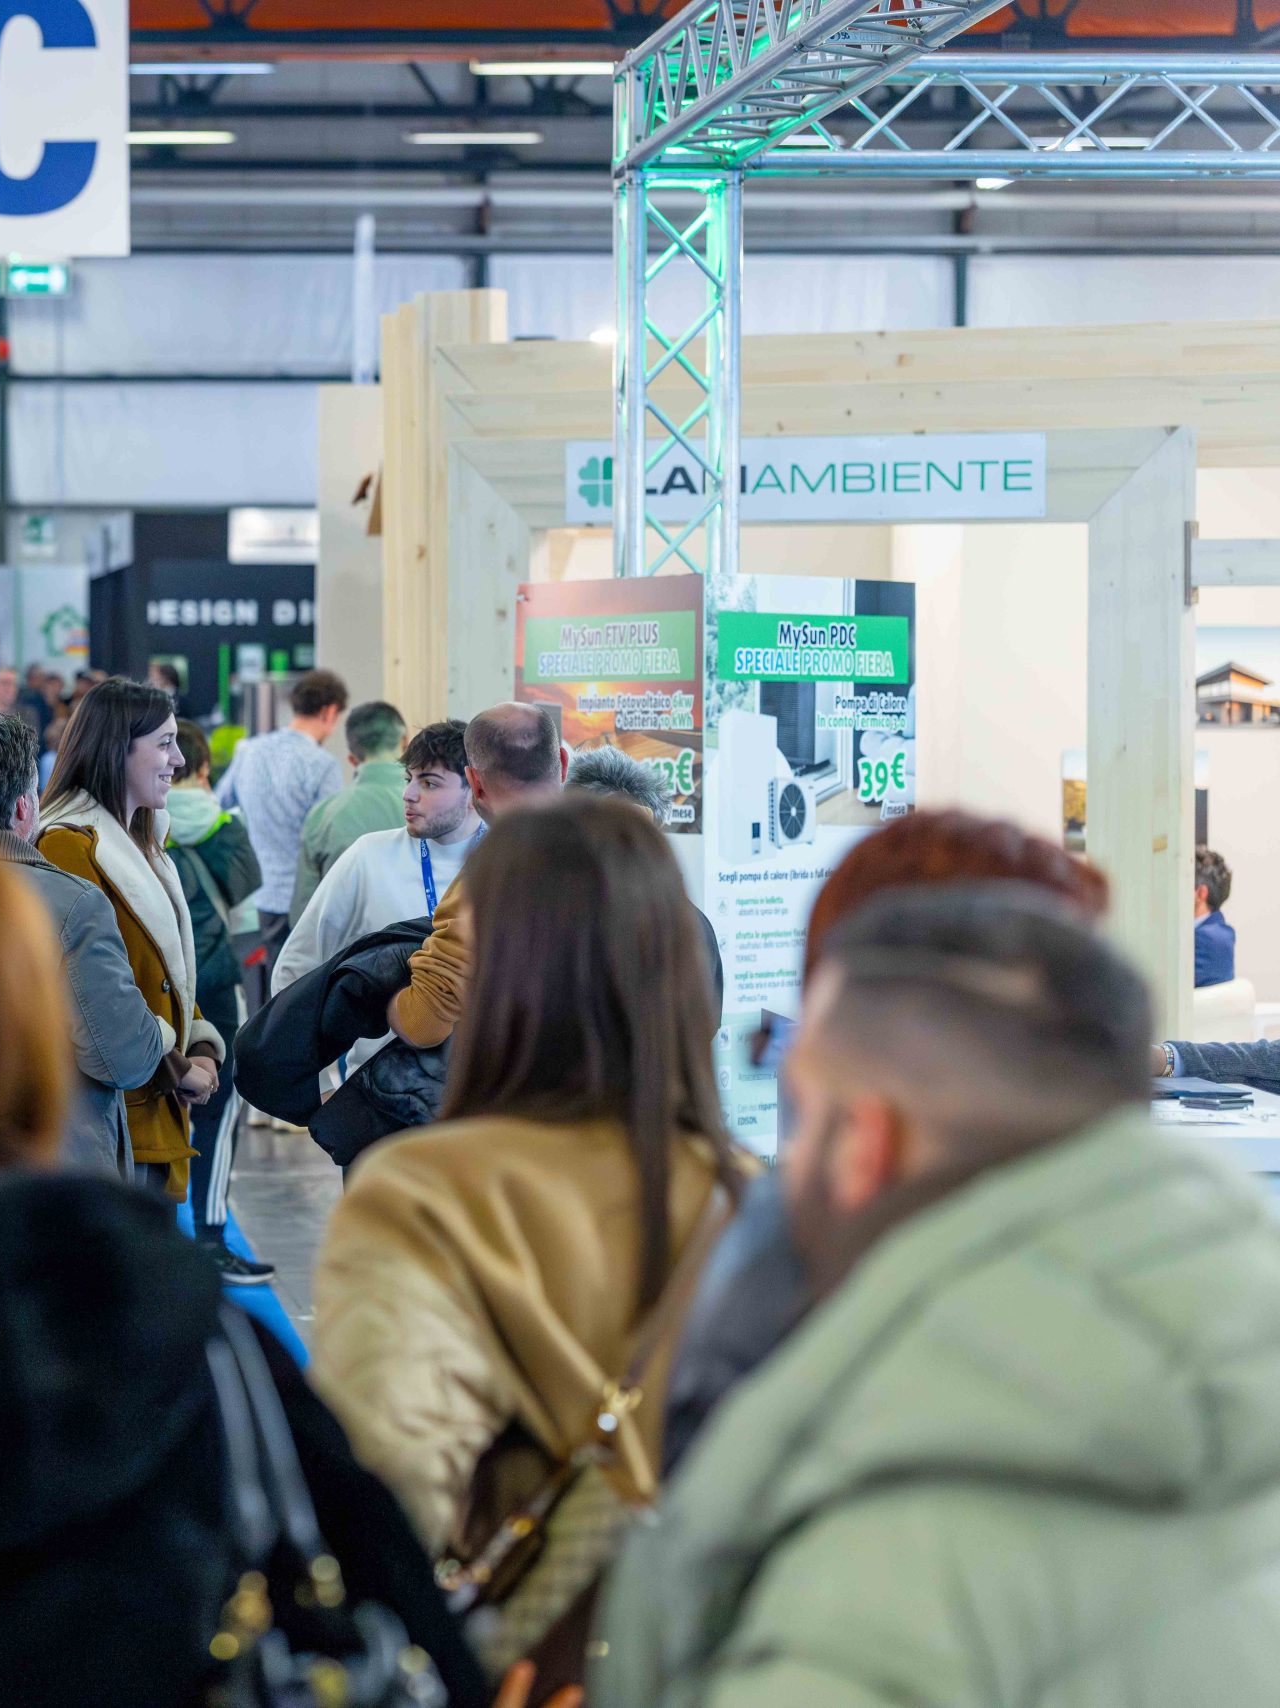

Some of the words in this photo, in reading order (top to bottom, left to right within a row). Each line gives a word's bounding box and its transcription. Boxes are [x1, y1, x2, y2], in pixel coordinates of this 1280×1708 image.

[272, 599, 314, 626] DI
[562, 626, 602, 649] MySun
[604, 624, 629, 646] FTV
[630, 622, 659, 645] PLUS
[779, 624, 826, 649] MySun
[830, 625, 856, 646] PDC
[539, 652, 594, 676] SPECIALE
[594, 650, 642, 675] PROMO
[643, 649, 680, 673] FIERA
[736, 650, 799, 673] SPECIALE
[802, 652, 854, 674] PROMO
[856, 653, 894, 675] FIERA
[579, 695, 616, 712] Impianto
[617, 693, 671, 709] Fotovoltaico
[835, 696, 867, 712] Pompa
[869, 695, 878, 709] di
[880, 695, 906, 710] Calore
[623, 714, 660, 728] batteria
[817, 714, 826, 728] In
[828, 715, 854, 728] conto
[856, 714, 891, 728] Termico
[739, 872, 761, 884] pompa
